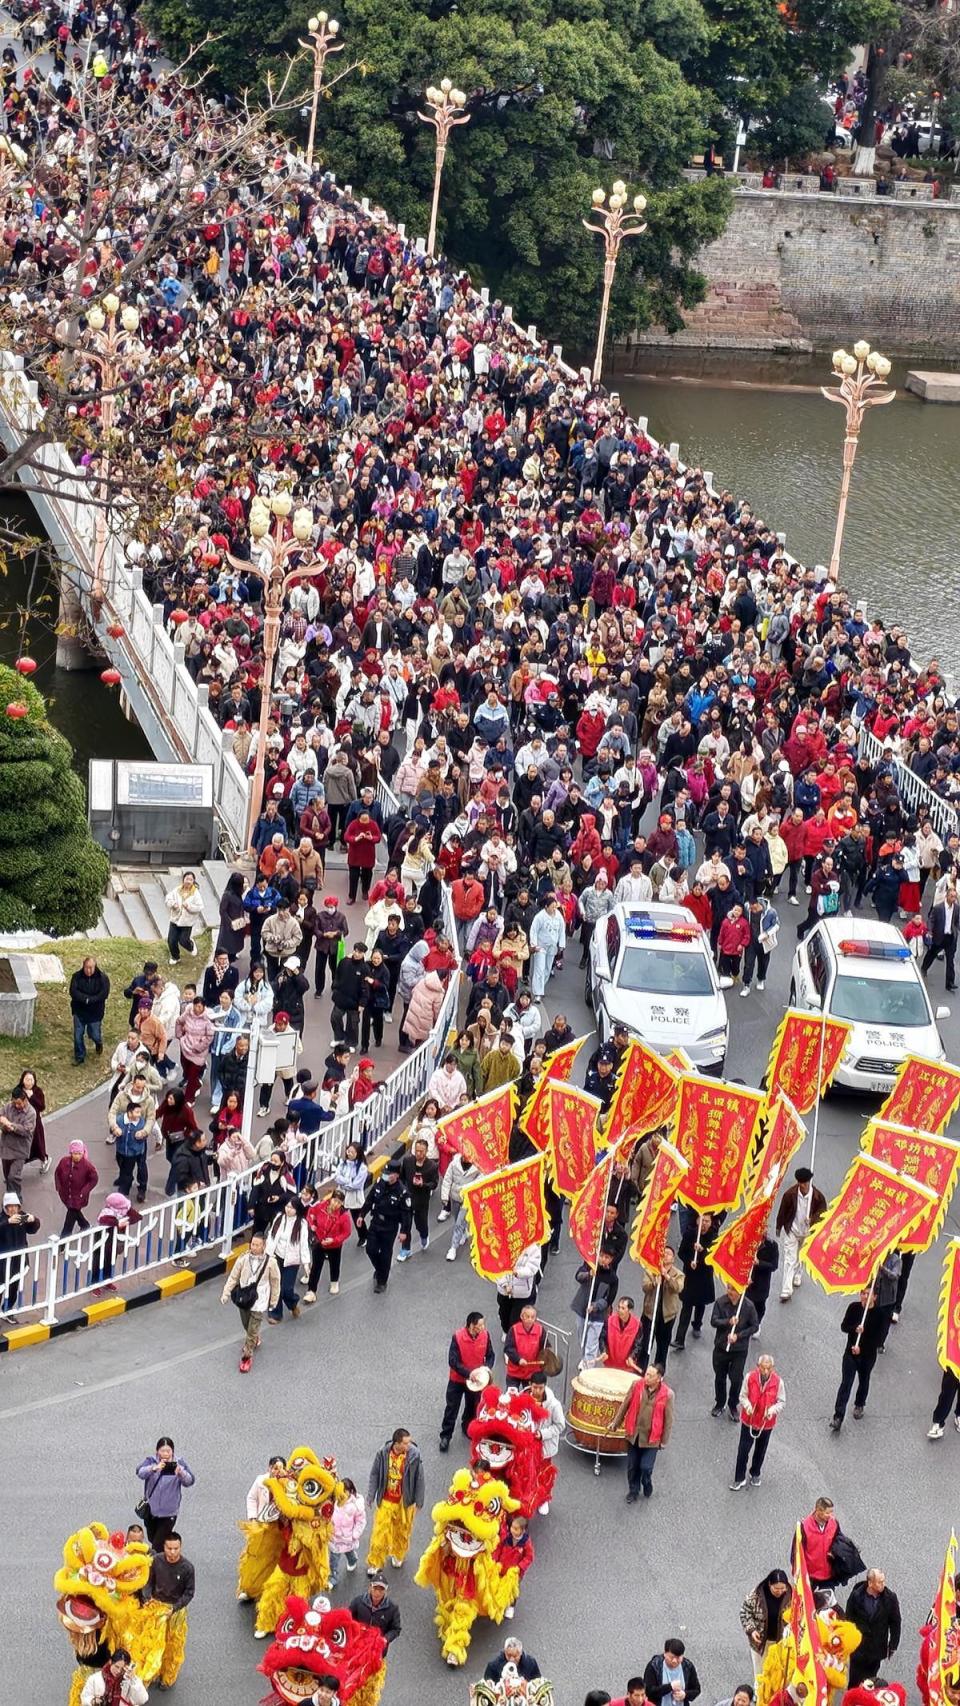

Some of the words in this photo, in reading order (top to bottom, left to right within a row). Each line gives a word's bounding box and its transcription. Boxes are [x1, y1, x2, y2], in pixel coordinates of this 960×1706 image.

[650, 1005, 690, 1017] 警察
[650, 1016, 691, 1025] POLICE
[865, 1030, 905, 1041] 警察
[866, 1040, 907, 1049] POLICE
